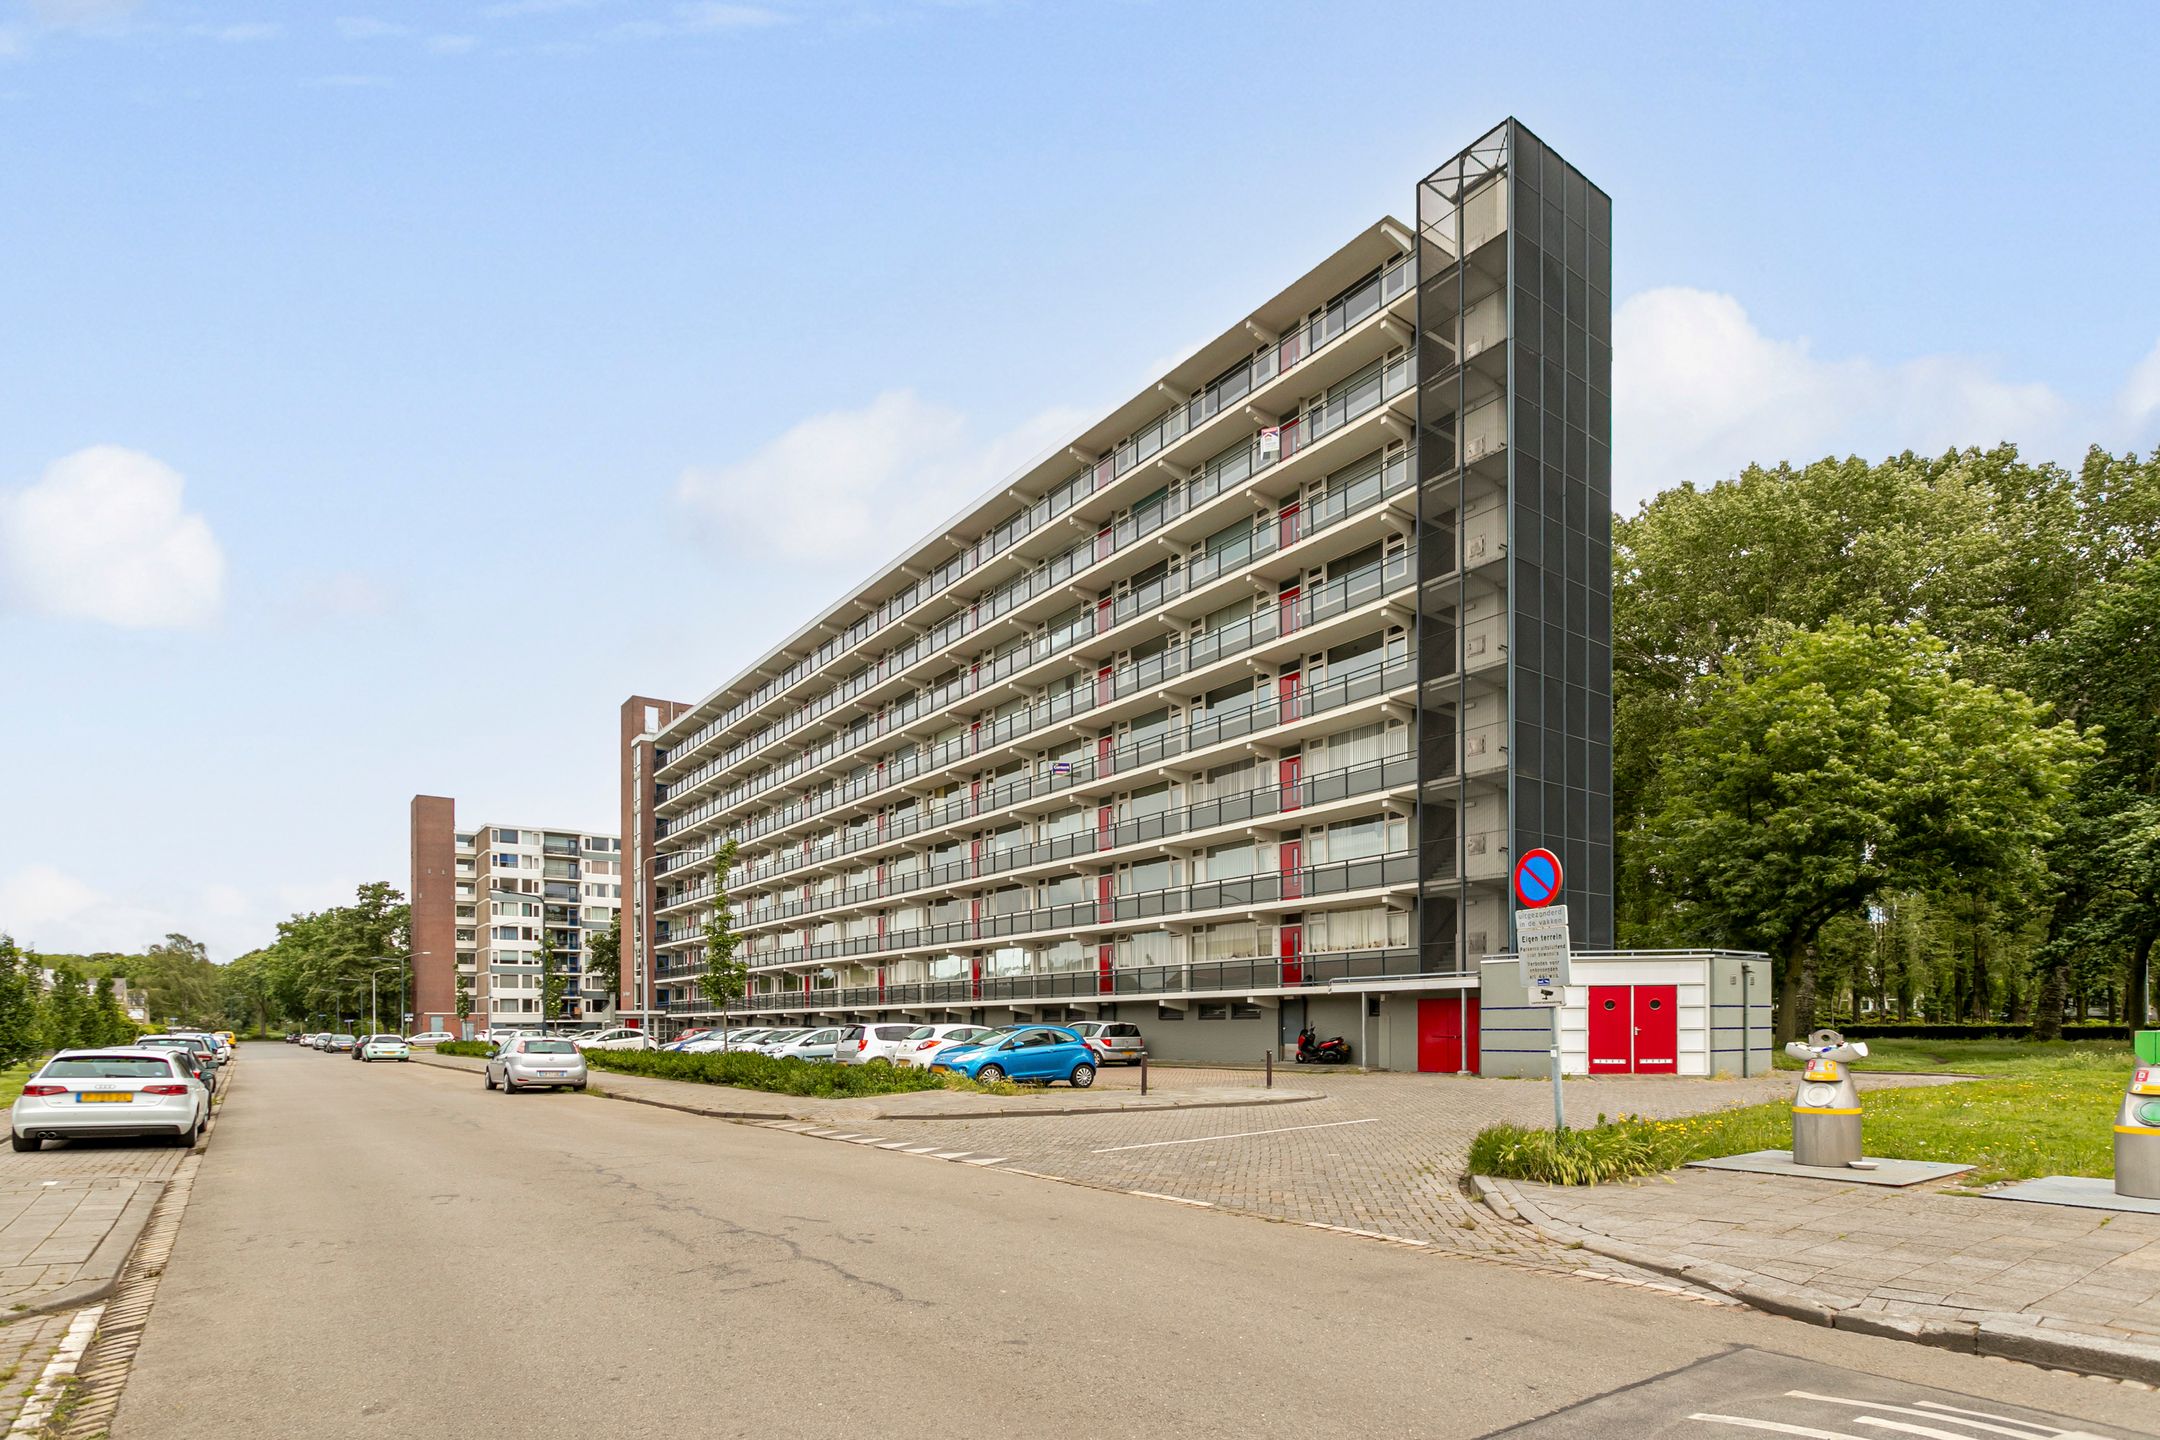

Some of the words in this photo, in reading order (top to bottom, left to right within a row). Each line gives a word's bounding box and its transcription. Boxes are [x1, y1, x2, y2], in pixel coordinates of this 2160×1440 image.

[1518, 908, 1562, 920] uitgezonderd
[1539, 917, 1563, 925] vakken
[1521, 935, 1539, 944] Eigen
[1540, 933, 1563, 942] terrein
